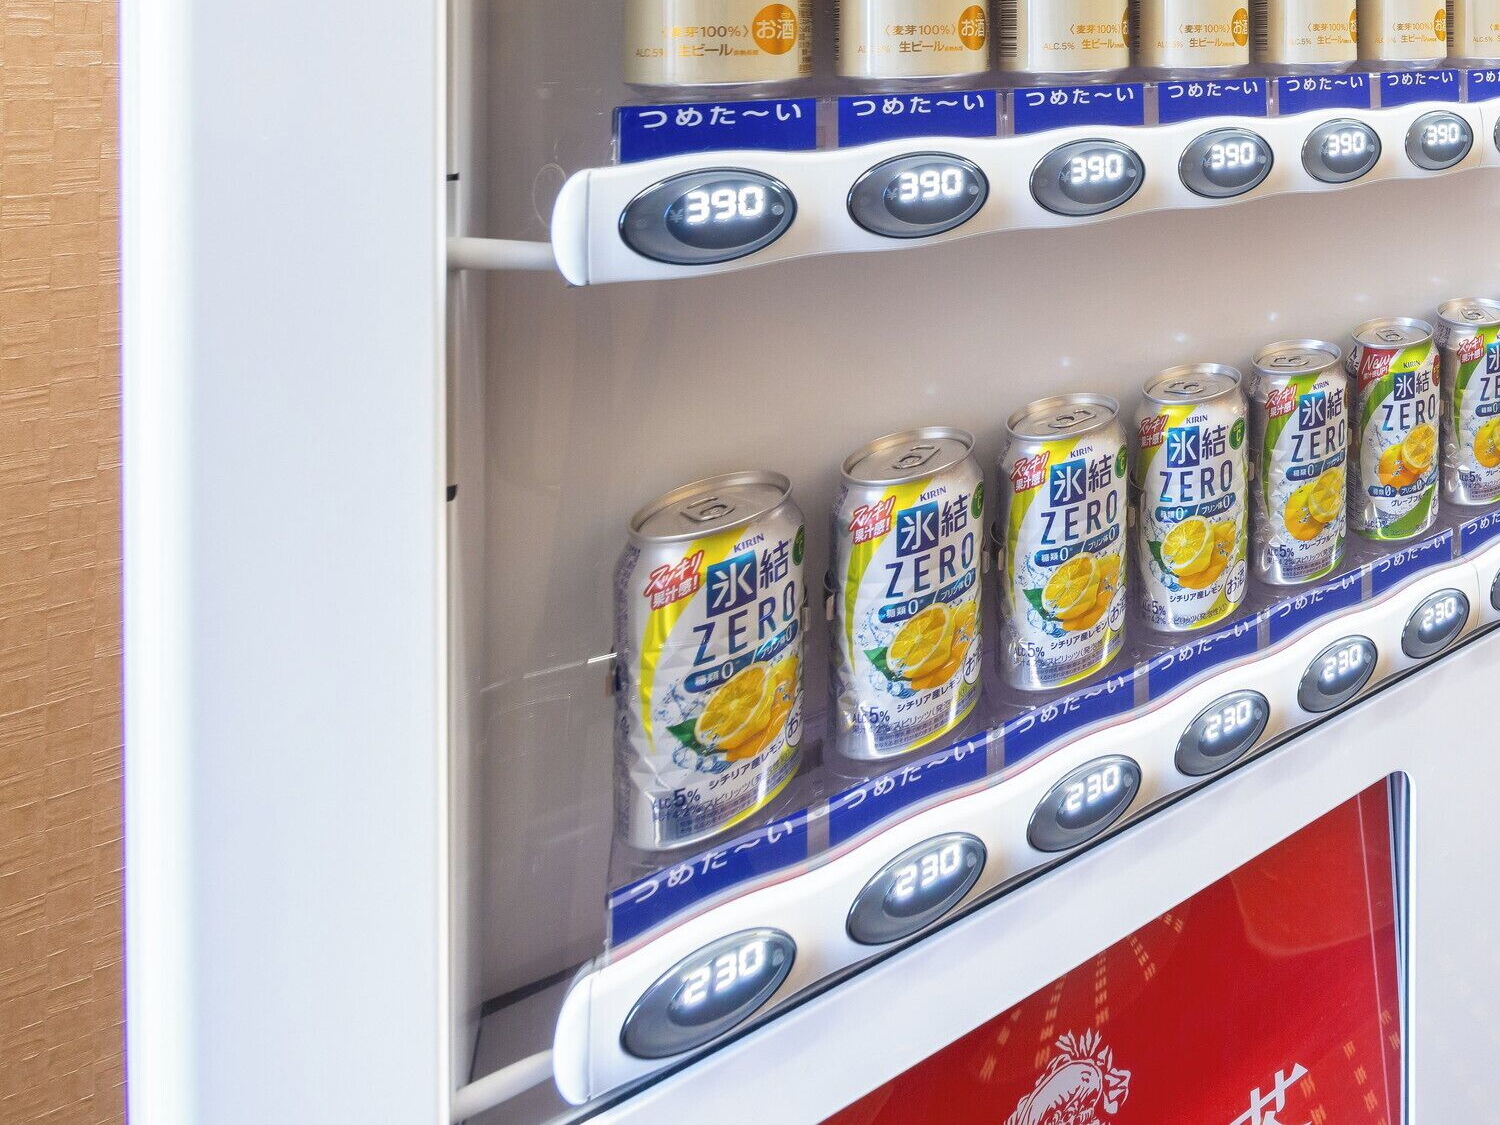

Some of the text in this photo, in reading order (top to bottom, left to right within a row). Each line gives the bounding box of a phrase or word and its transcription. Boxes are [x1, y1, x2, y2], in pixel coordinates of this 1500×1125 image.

[1427, 125, 1459, 144] 390
[1362, 353, 1391, 372] New
[1403, 359, 1421, 369] KIRIN
[1396, 370, 1430, 397] 氷結
[1138, 414, 1169, 436] スッキリ
[1185, 414, 1208, 425] KIRIN
[1302, 388, 1342, 427] 氷結
[1381, 394, 1436, 432] ZERO
[1070, 445, 1094, 459] KIRIN
[1169, 425, 1227, 466] 氷結
[1291, 419, 1345, 463] ZERO
[1010, 451, 1050, 482] スッキリ
[1053, 453, 1112, 502] 氷結
[1159, 460, 1233, 503] ZERO
[849, 496, 896, 532] スッキリ
[900, 493, 968, 551] 氷結
[1040, 490, 1118, 546] ZERO
[644, 551, 703, 597] スッキリ
[711, 540, 792, 609] 氷結
[885, 532, 974, 598] ZERO
[1169, 584, 1223, 603] シチリア産レモン
[1423, 597, 1456, 628] 230
[692, 580, 795, 667] ZERO
[1050, 621, 1108, 650] シチリア産レモン
[1323, 645, 1362, 680] 230
[896, 676, 961, 713] シチリア産レモン
[1206, 701, 1251, 740] 230
[1066, 765, 1121, 813] 230
[897, 844, 959, 897] 230
[683, 943, 763, 1005] 230
